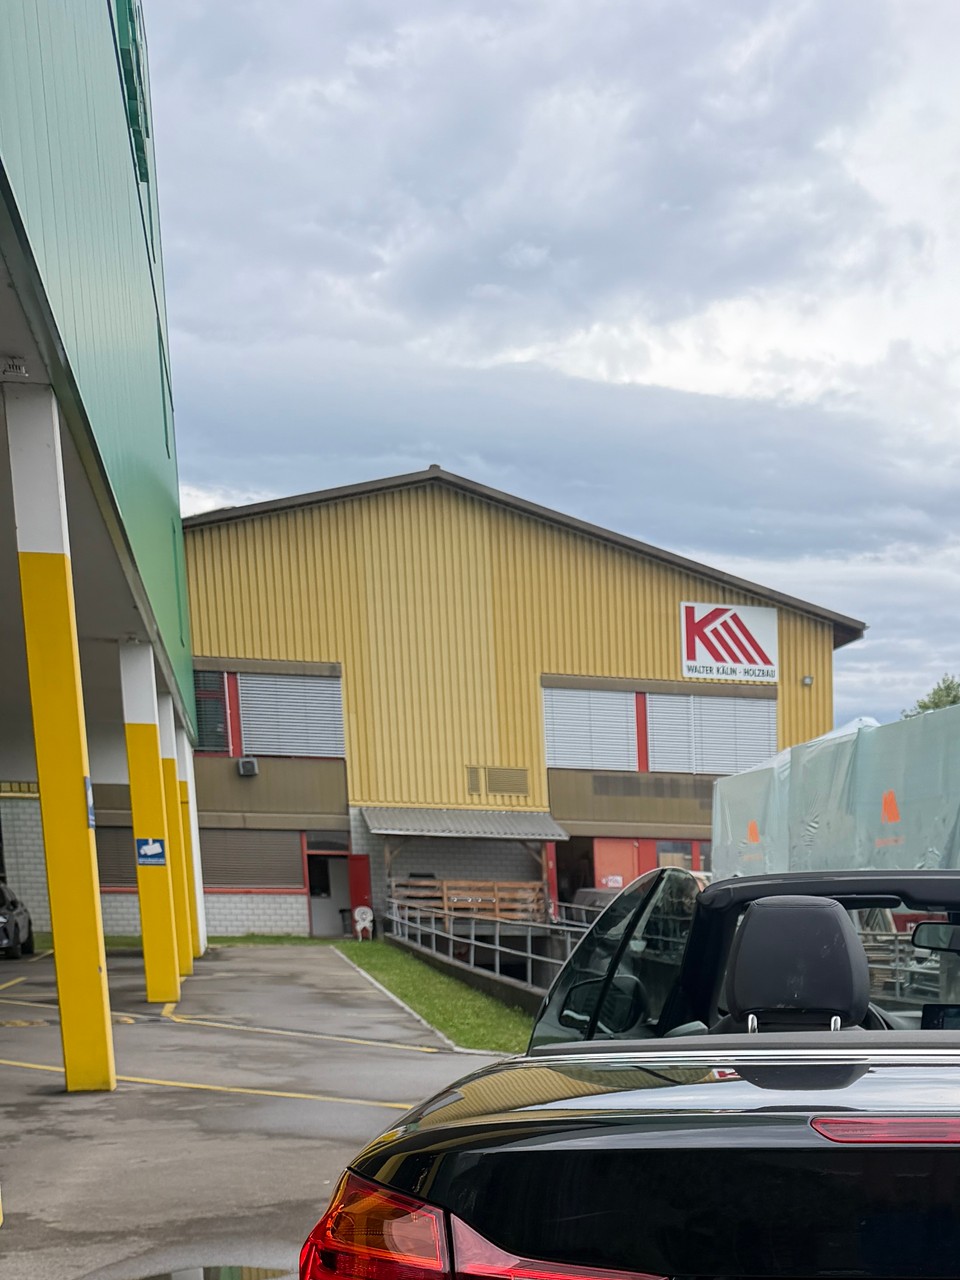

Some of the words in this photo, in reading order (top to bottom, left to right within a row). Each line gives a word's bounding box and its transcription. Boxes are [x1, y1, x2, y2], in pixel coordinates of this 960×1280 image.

[686, 664, 714, 675] WALTER
[716, 665, 737, 676] KÄLIN
[743, 668, 776, 678] HOLZBAU
